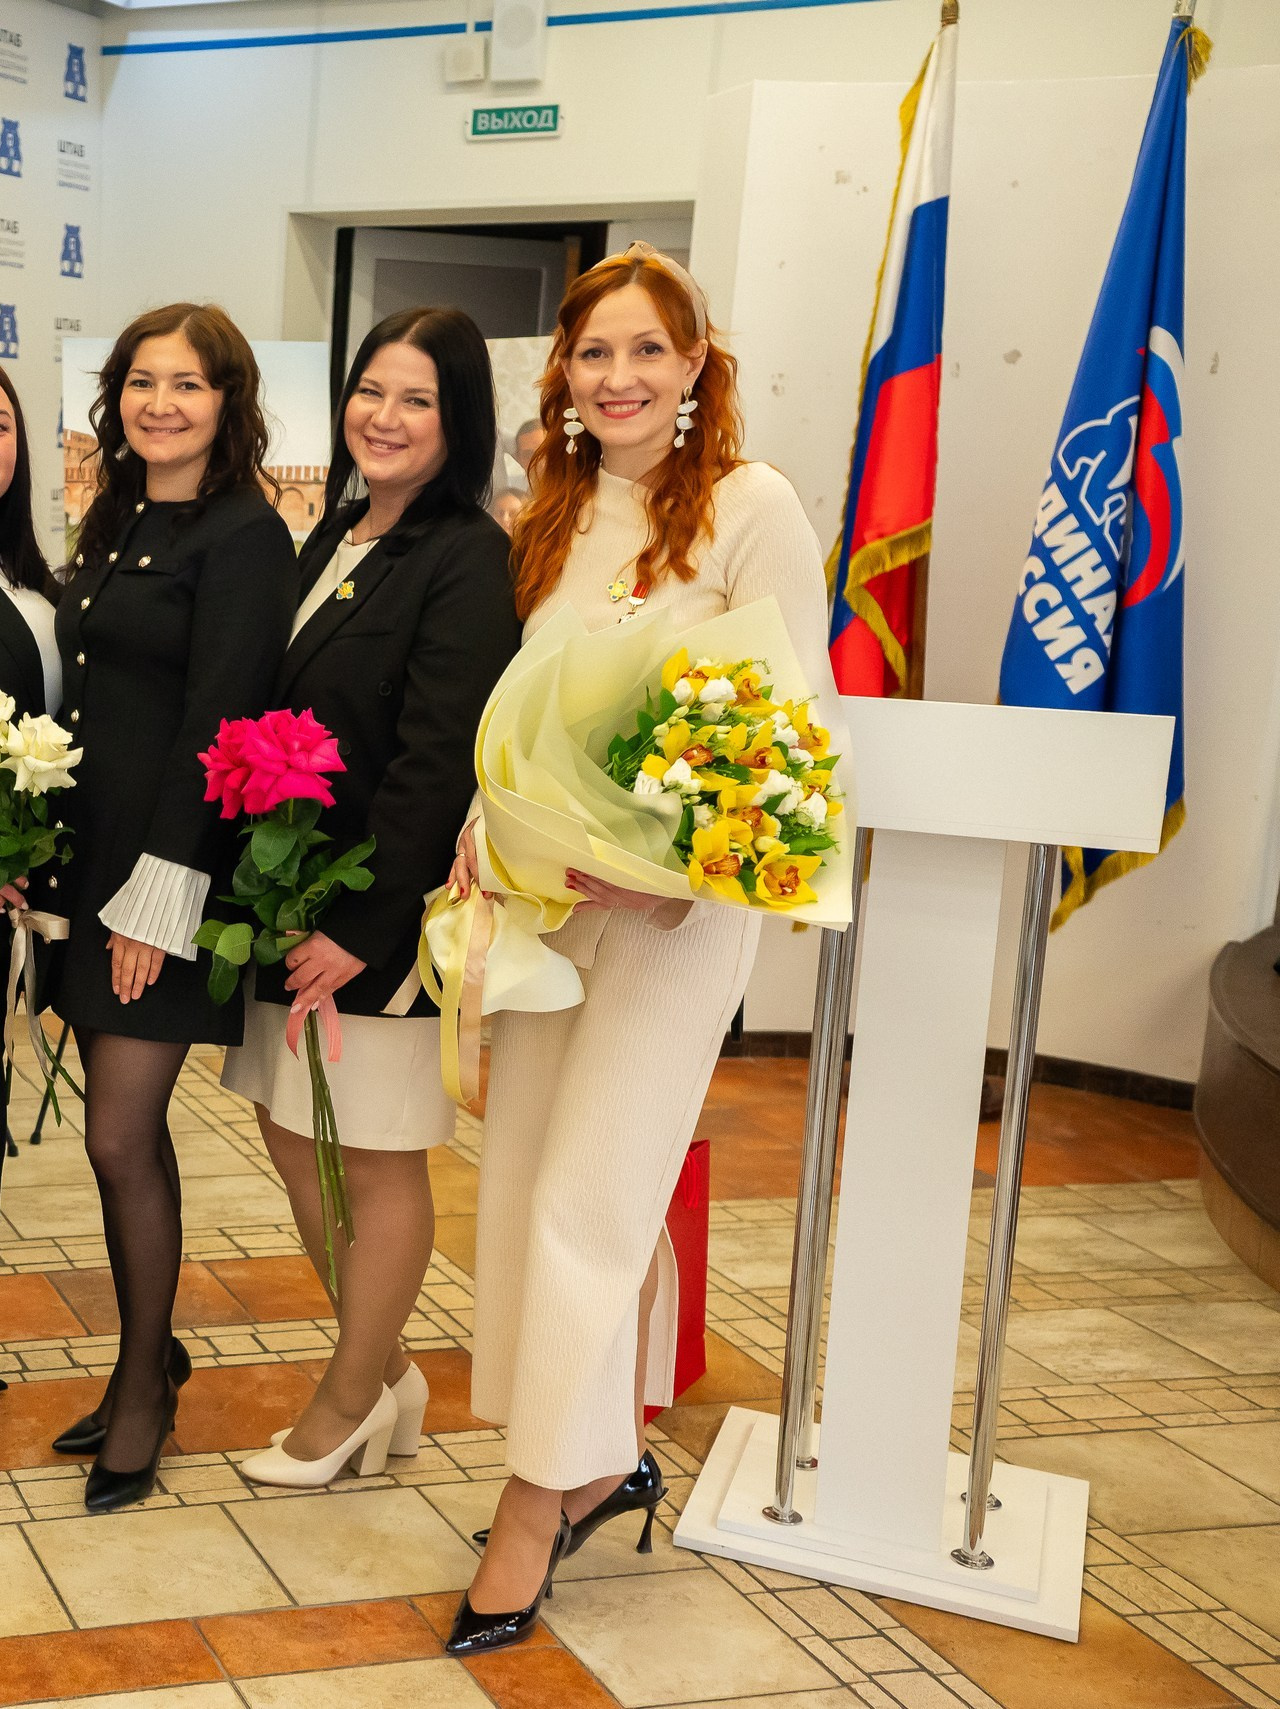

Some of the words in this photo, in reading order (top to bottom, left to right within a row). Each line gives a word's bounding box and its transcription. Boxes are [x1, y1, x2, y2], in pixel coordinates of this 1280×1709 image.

[476, 109, 554, 131] ВЫХОД
[1019, 555, 1106, 695] ССИЯ
[1034, 464, 1118, 656] ДИНА
